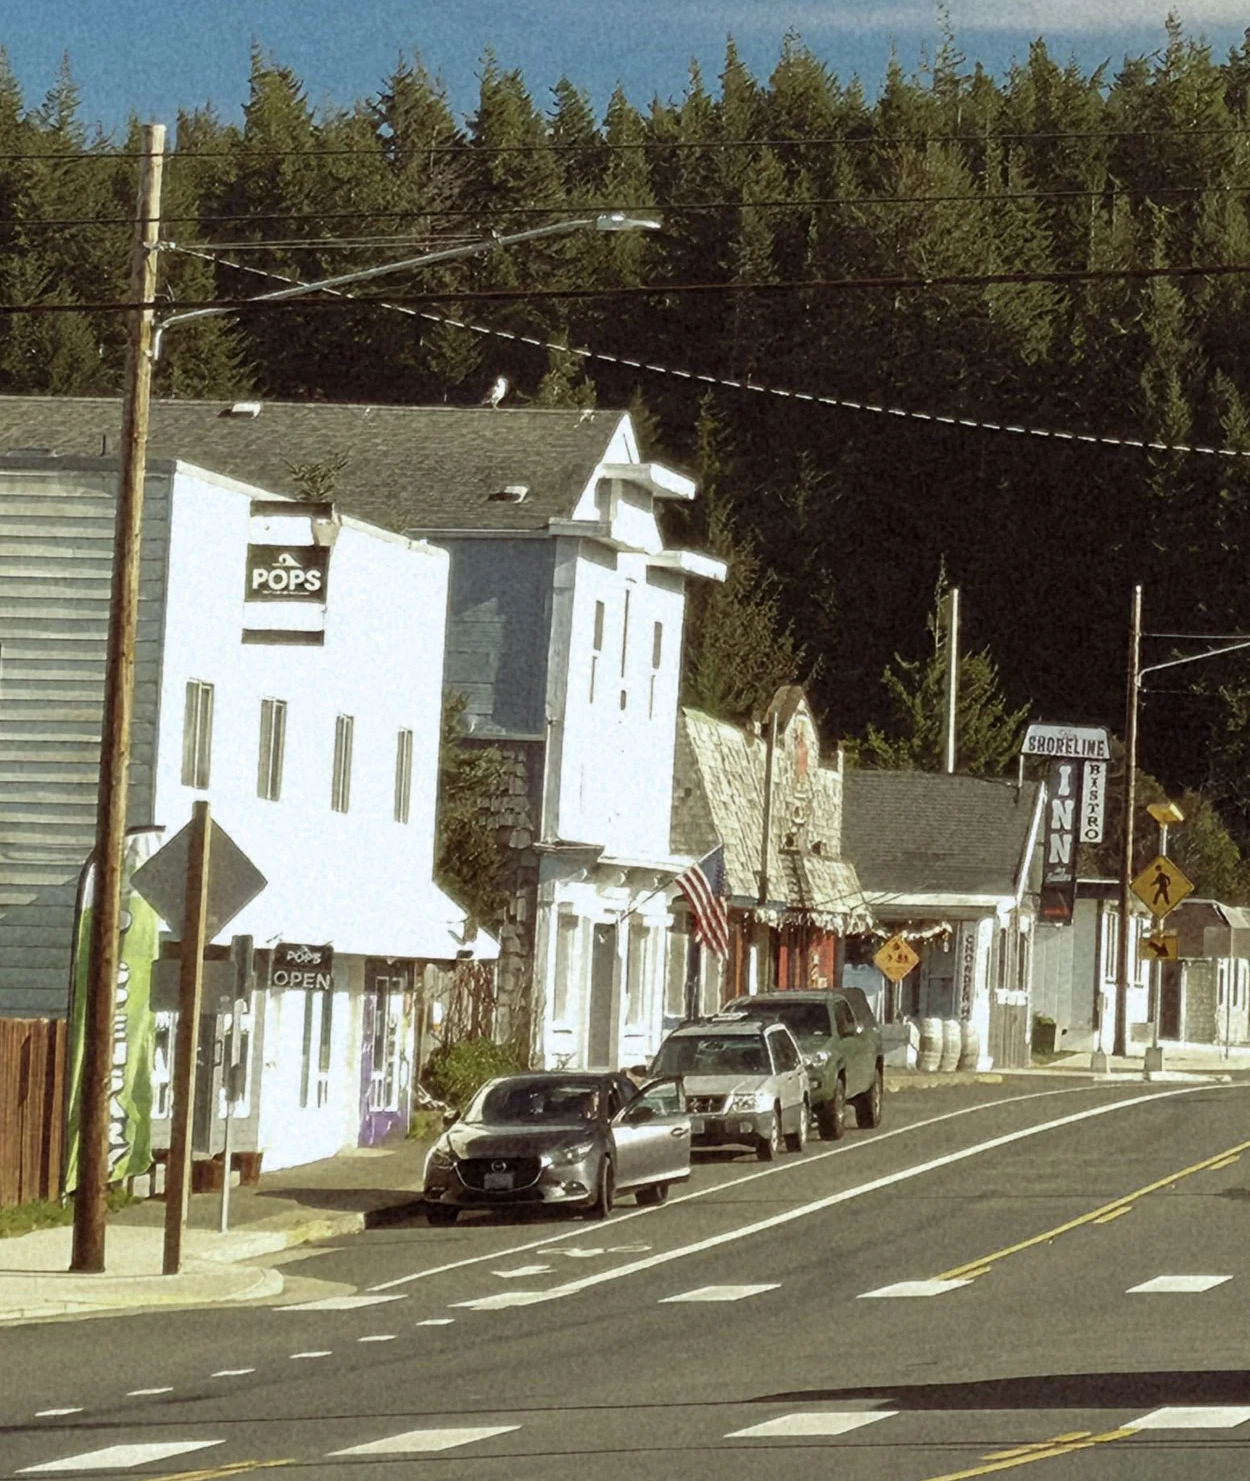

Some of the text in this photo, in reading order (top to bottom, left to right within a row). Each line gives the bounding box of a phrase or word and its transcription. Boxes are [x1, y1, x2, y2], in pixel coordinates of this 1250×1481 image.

[252, 568, 322, 592] POPS
[1028, 735, 1105, 757] SHORELINE
[1084, 764, 1101, 840] BISTRO
[1048, 765, 1075, 864] INN
[286, 950, 322, 965] POPS
[273, 970, 331, 990] OPEN
